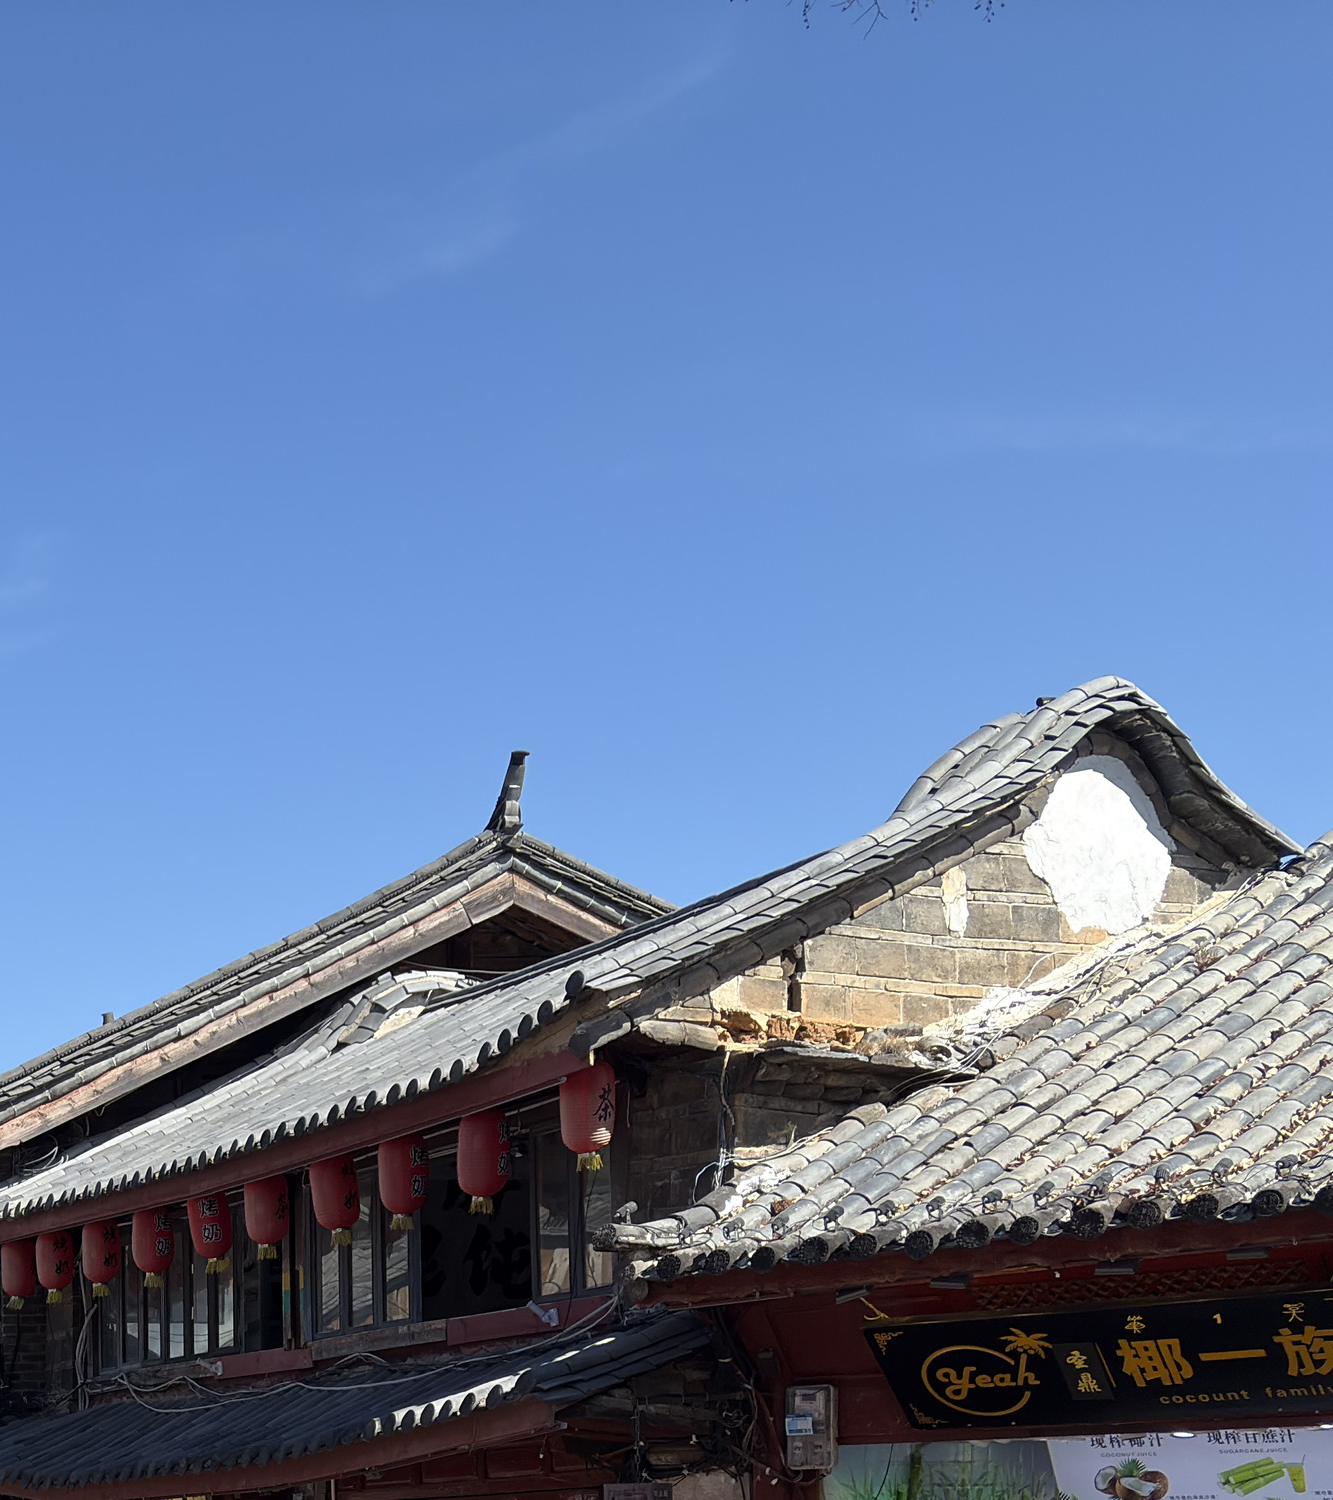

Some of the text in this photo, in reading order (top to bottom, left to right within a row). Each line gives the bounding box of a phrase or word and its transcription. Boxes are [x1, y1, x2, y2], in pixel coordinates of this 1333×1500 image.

[593, 1083, 615, 1122] 茶
[154, 1213, 172, 1256] 烤奶
[199, 1198, 222, 1243] 烤奶
[936, 1352, 1040, 1400] Yeah
[1116, 1326, 1333, 1388] 椰一族
[1159, 1390, 1250, 1405] cocount
